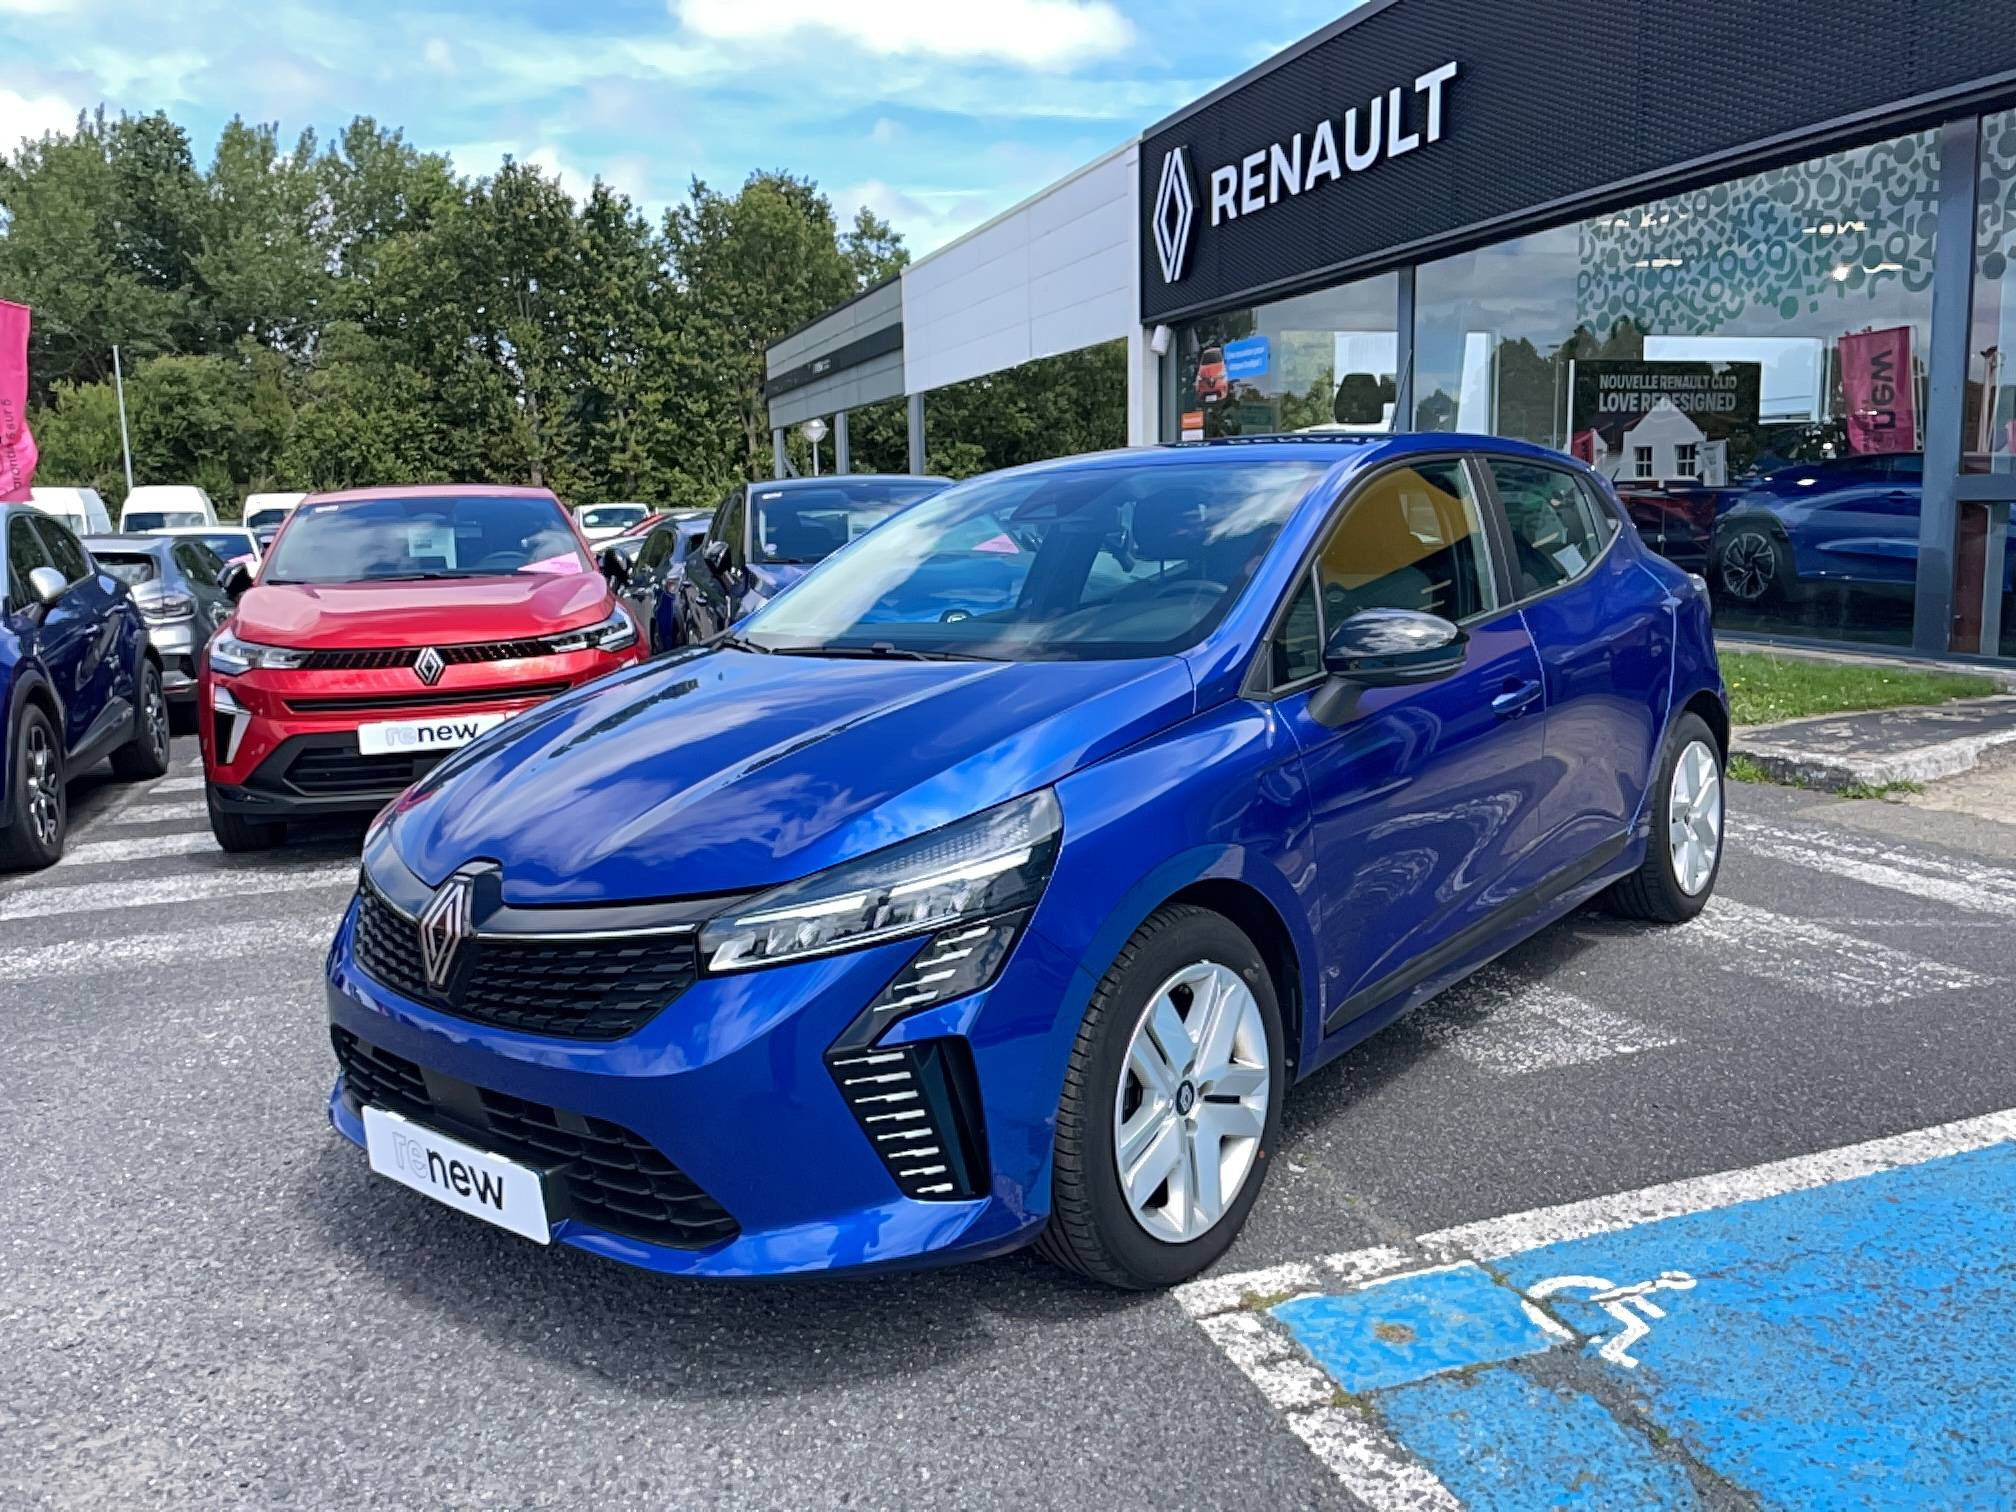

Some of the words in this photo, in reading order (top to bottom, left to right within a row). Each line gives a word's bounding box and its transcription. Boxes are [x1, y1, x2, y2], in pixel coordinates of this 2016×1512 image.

[1210, 60, 1458, 227] RENAULT
[1599, 374, 1658, 390] NOUVELLE
[1660, 374, 1709, 390] RENAULT
[1711, 374, 1737, 390] CLIO
[1599, 392, 1640, 412] LOVE
[385, 722, 478, 747] renew
[392, 1131, 503, 1210] renew
